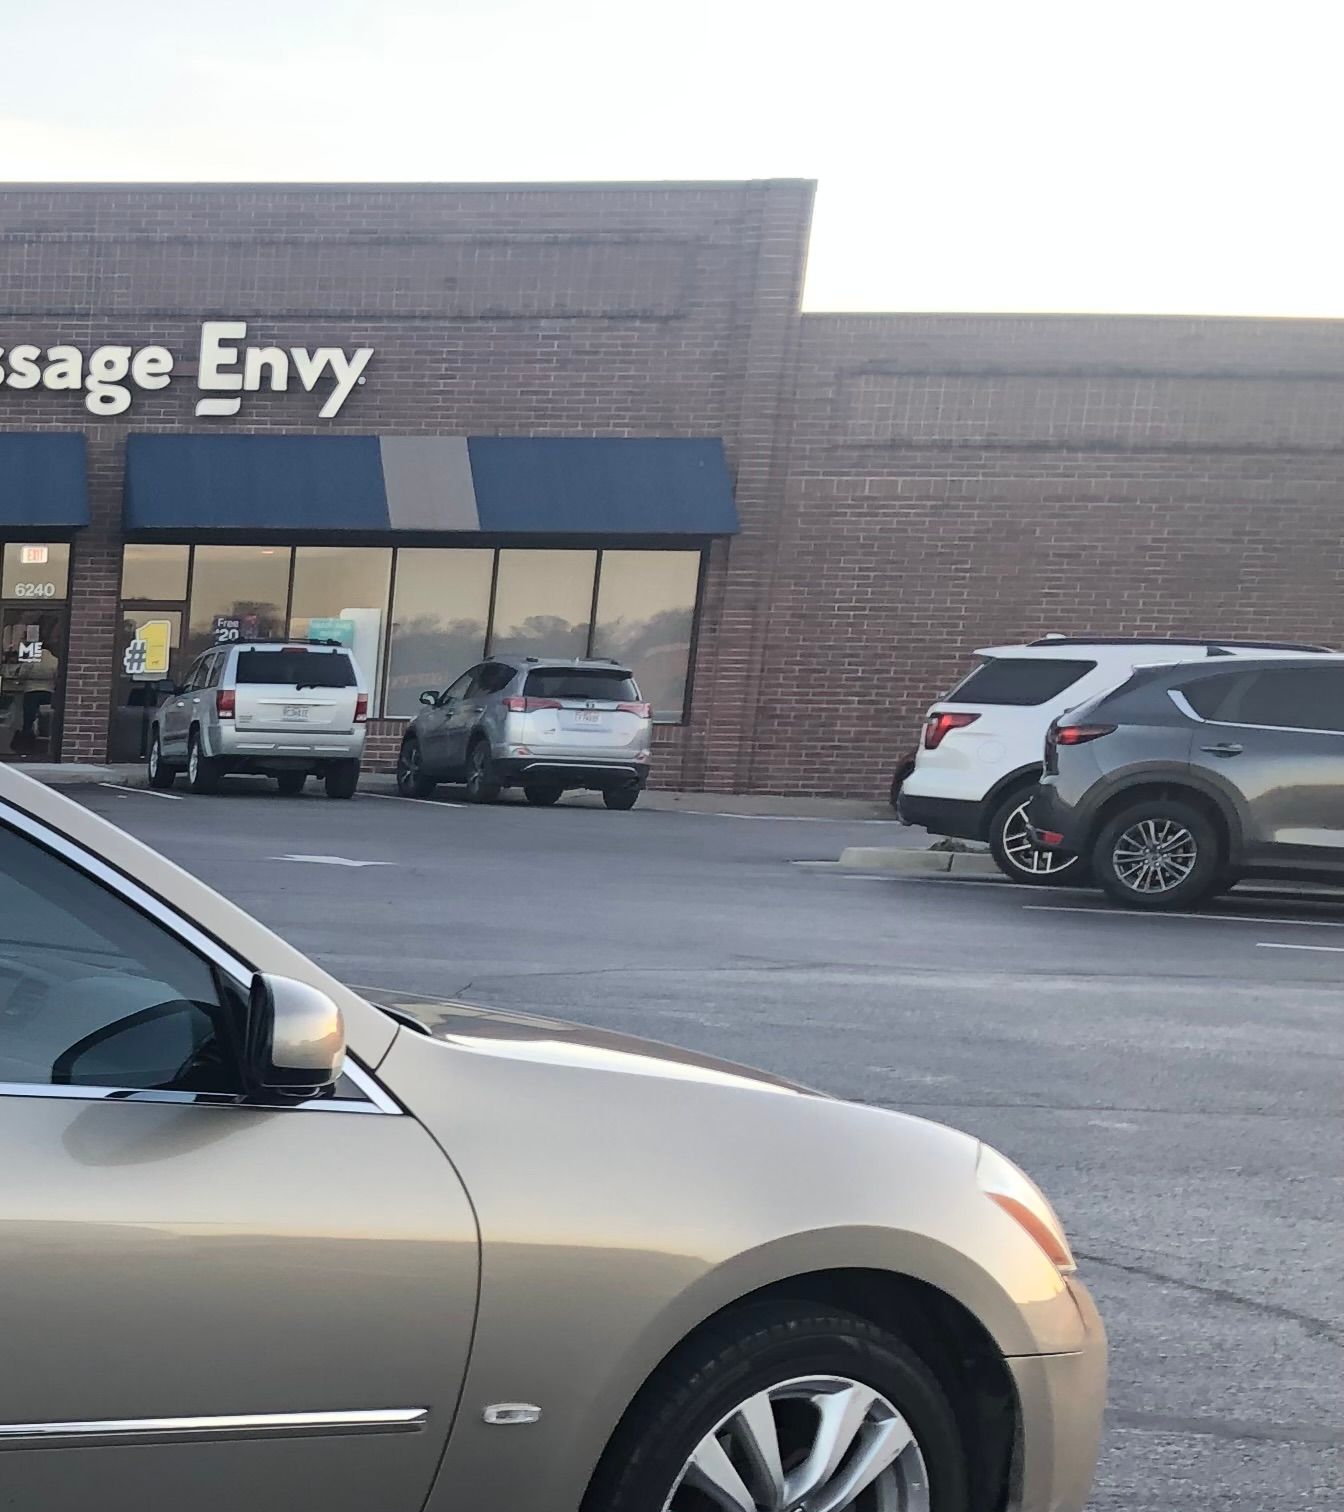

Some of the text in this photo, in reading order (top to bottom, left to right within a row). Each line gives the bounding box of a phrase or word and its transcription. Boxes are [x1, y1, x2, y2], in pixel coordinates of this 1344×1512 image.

[197, 320, 375, 418] Envy
[15, 583, 55, 597] 6240
[217, 618, 239, 627] Free
[18, 641, 43, 657] ME
[124, 620, 171, 673] #1
